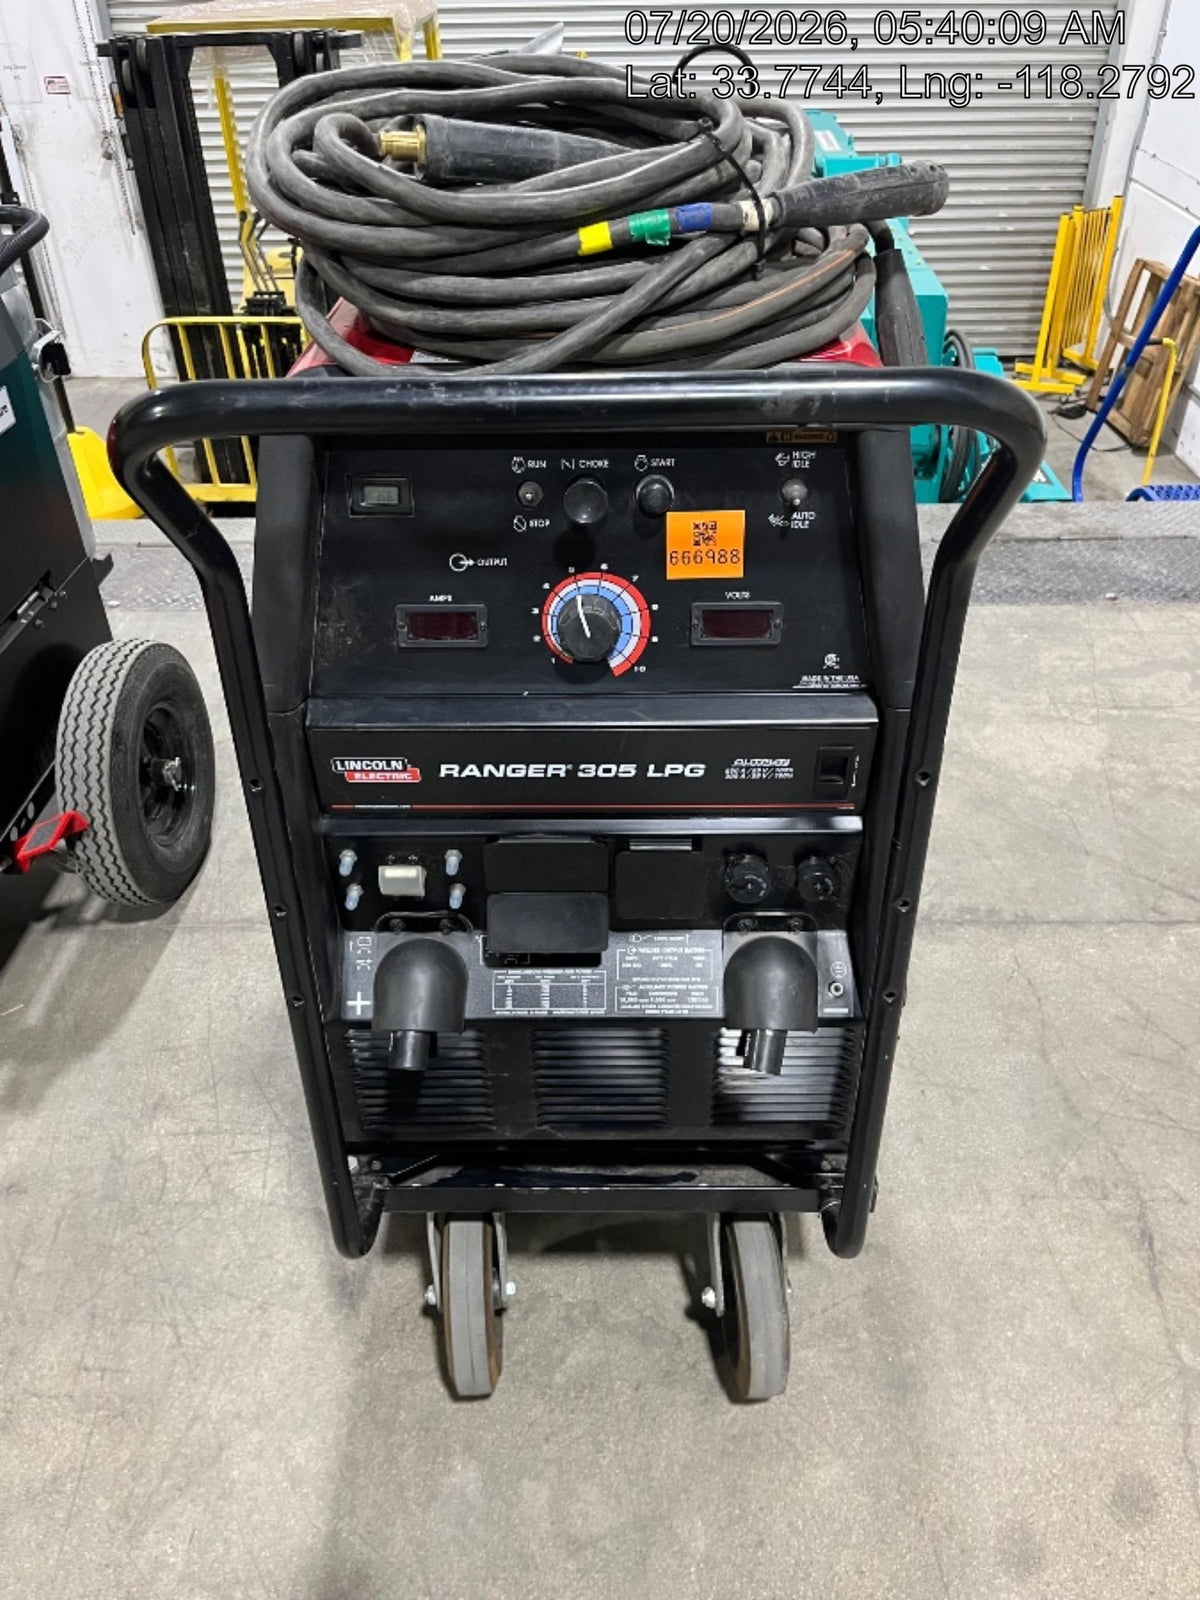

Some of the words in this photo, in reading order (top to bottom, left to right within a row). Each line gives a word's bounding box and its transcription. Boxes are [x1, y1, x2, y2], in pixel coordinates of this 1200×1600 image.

[527, 460, 547, 468] RUN
[578, 459, 609, 469] CHOKE
[650, 458, 676, 468] START
[792, 460, 810, 468] IDLE
[791, 511, 816, 520] AUTO
[529, 518, 550, 528] STOP
[790, 520, 810, 529] IDLE
[669, 548, 741, 566] 666988
[335, 760, 404, 771] LINCOLN
[577, 763, 638, 778] 305
[647, 763, 706, 778] LPG
[353, 772, 413, 780] ELECTRIC
